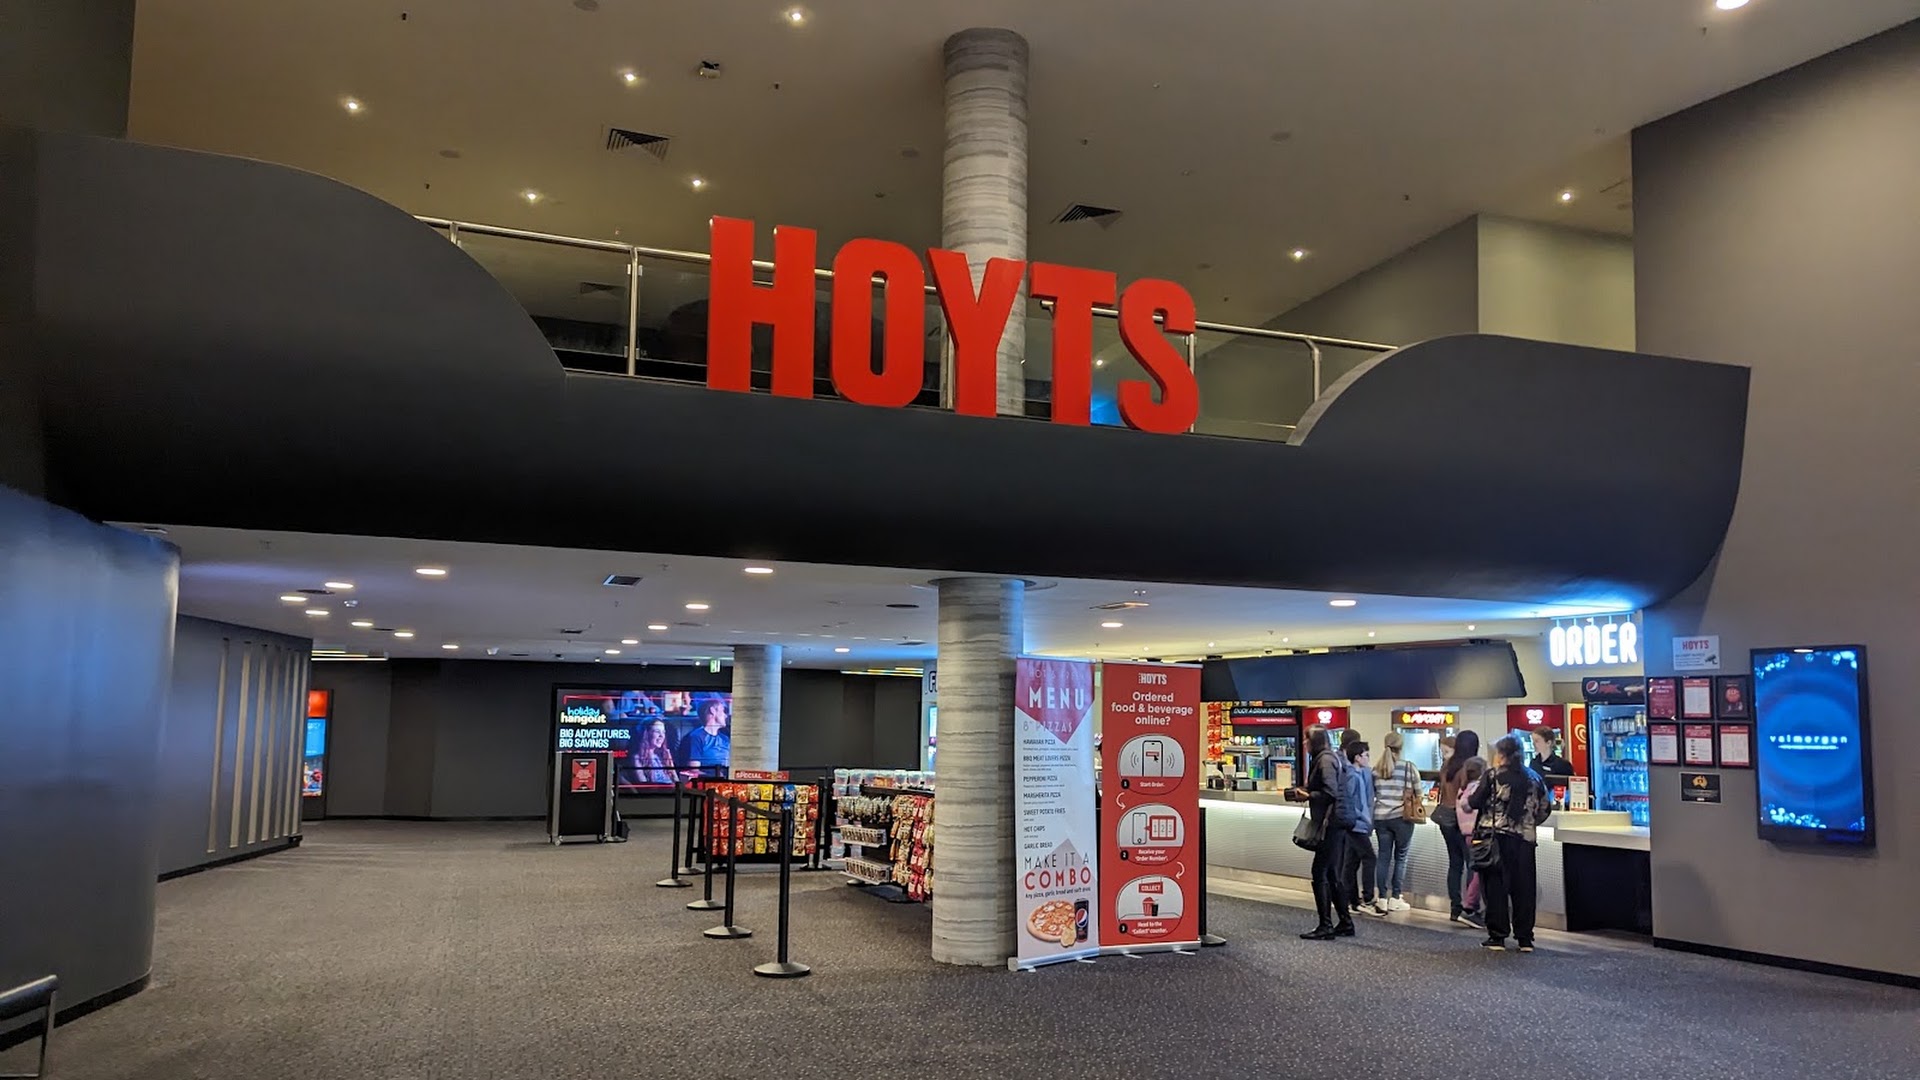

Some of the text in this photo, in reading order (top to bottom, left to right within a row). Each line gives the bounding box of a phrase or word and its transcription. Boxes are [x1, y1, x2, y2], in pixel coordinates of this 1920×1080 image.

[706, 215, 1198, 435] HOYTS
[1549, 621, 1637, 667] ORDER
[1682, 640, 1709, 650] HOYTS
[1140, 673, 1167, 684] HOYTS
[1029, 686, 1084, 710] MENU
[1132, 692, 1174, 702] Ordered
[567, 706, 600, 716] holiday
[1111, 702, 1193, 716] food & beverage
[561, 712, 606, 725] hangout
[1135, 715, 1171, 725] online?
[1036, 721, 1073, 733] PIZZAS
[560, 729, 631, 740] BIG ADVENTURES,
[559, 739, 609, 748] BIG SAVINGS
[736, 771, 762, 779] SPECIAL
[1024, 852, 1089, 869] MAKE IT A
[1024, 867, 1091, 890] COMBO
